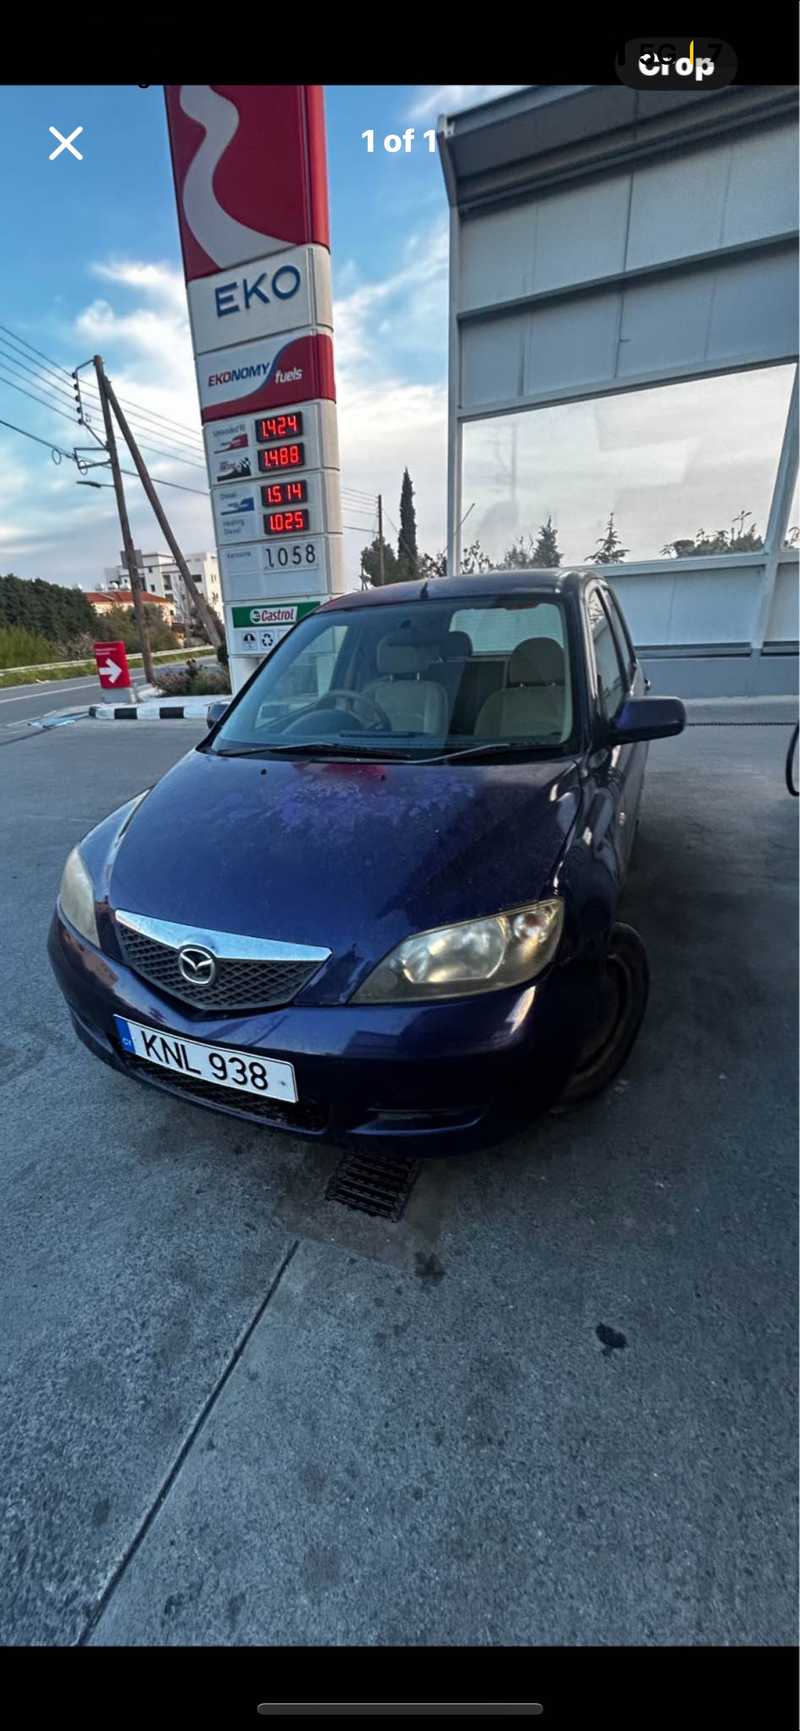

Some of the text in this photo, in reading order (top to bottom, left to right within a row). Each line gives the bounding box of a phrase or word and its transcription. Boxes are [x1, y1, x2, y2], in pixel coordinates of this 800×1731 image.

[215, 265, 300, 317] EKO
[208, 362, 303, 387] EKONOMY fuels
[261, 608, 295, 622] Castrol
[141, 1030, 269, 1090] KNL 938
